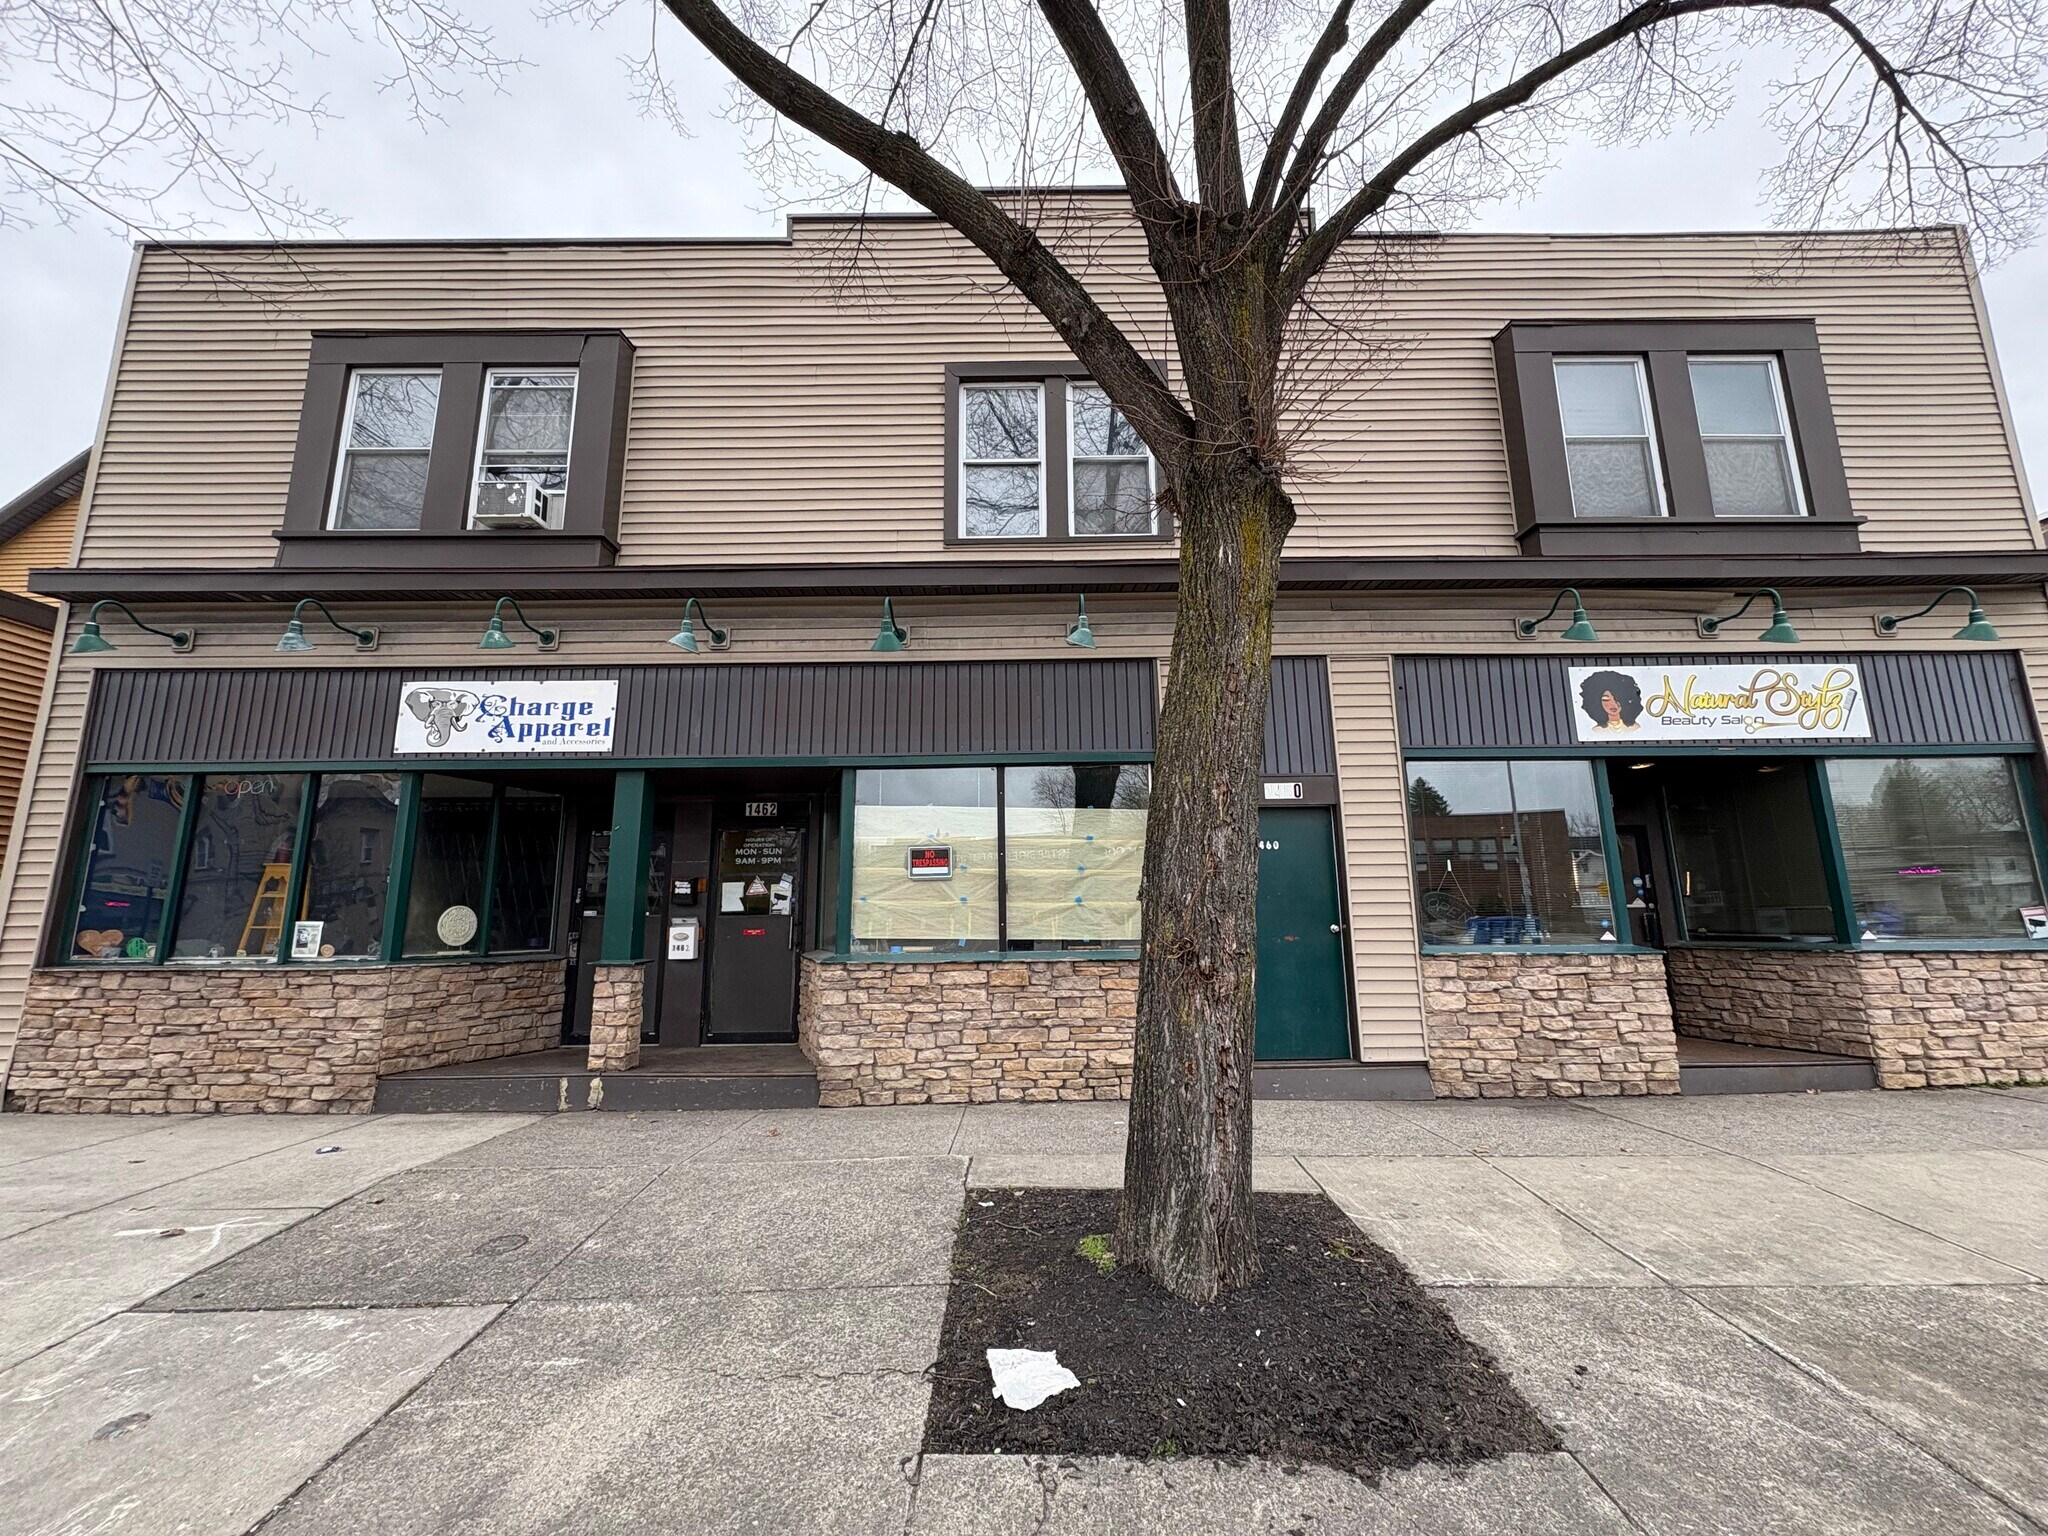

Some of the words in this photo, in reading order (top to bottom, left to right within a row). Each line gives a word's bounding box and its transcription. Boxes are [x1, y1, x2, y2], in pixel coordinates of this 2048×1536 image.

[1646, 668, 1781, 718] Natural
[1765, 668, 1854, 730] Stylz
[475, 693, 594, 723] Charge
[1661, 715, 1718, 728] Beauty
[1721, 714, 1765, 727] Salon
[487, 716, 612, 743] Apparel
[541, 737, 558, 746] and
[560, 737, 606, 746] Accessories
[747, 803, 777, 816] 1462
[762, 847, 783, 855] SUN
[925, 850, 935, 859] NO
[735, 857, 756, 865] 9AM
[761, 857, 782, 865] 9PM
[912, 858, 949, 867] TRESPASSING
